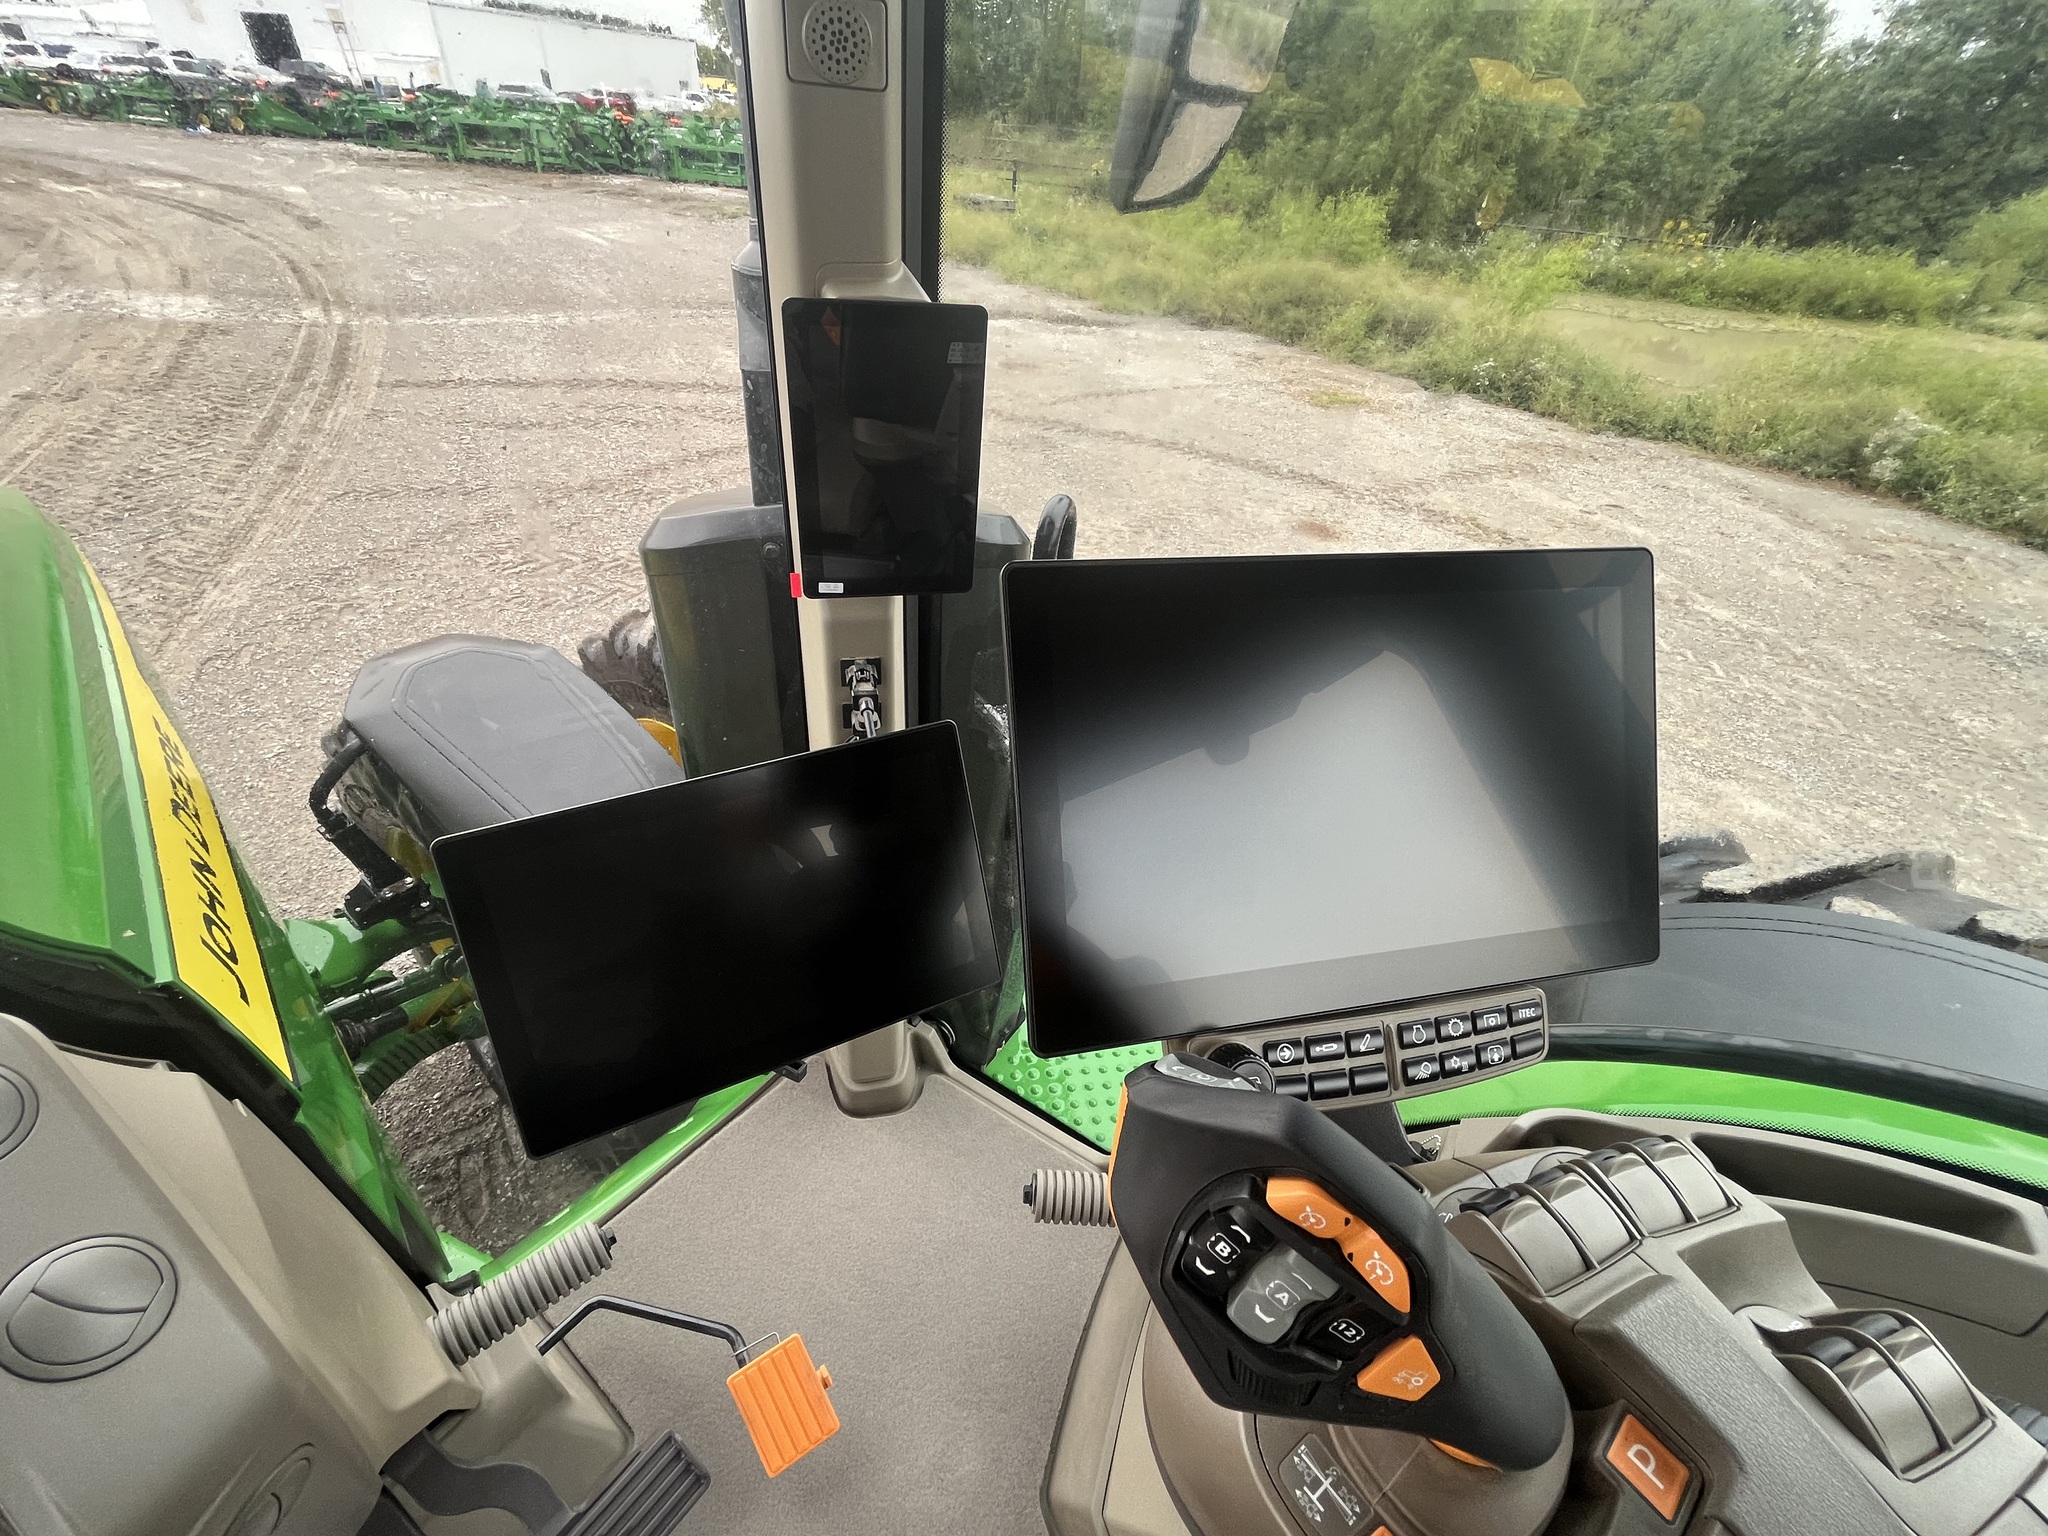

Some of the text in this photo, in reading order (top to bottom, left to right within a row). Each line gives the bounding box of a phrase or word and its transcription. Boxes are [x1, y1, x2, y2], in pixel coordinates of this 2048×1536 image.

[152, 715, 250, 1008] JOHN DEERE
[1214, 1240, 1232, 1258] B
[1273, 1291, 1290, 1306] A
[1337, 1322, 1357, 1338] 12
[1626, 1443, 1665, 1490] P
